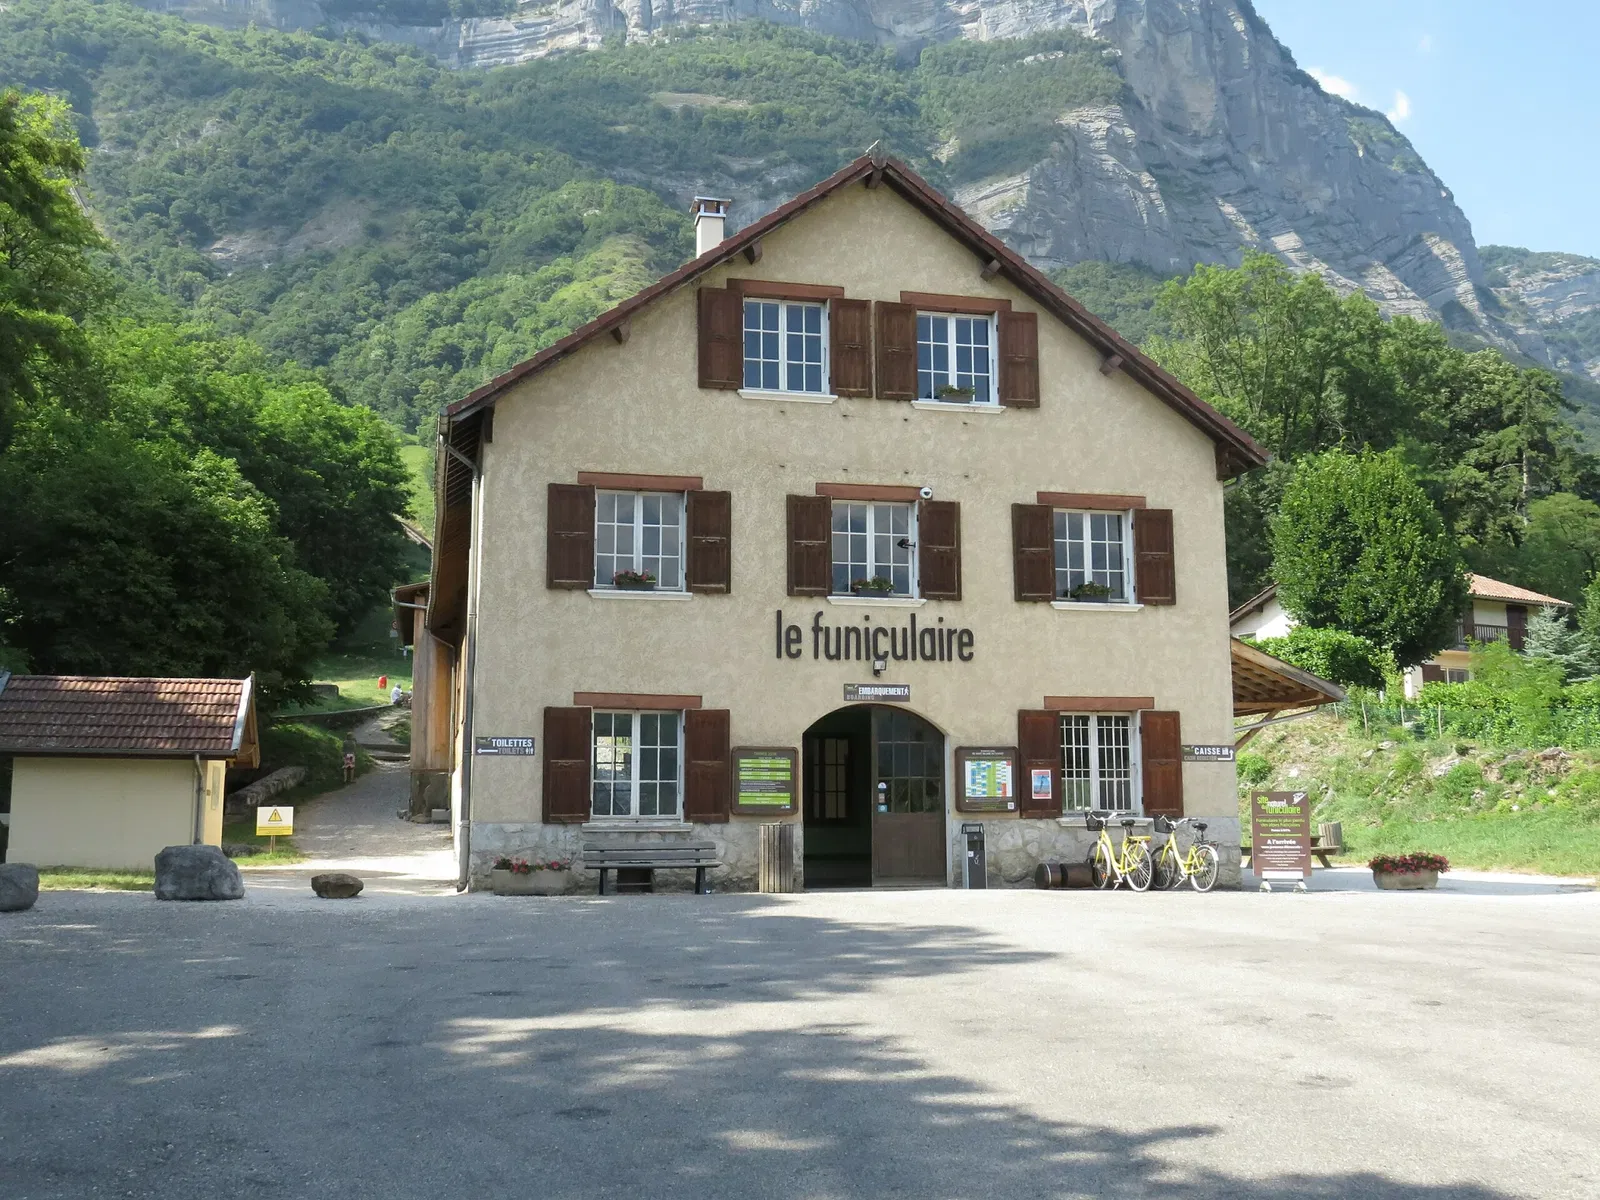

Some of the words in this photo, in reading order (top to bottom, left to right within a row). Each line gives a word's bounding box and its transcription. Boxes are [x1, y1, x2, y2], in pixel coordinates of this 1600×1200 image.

[776, 609, 802, 659] le
[812, 610, 974, 662] funiculaire
[859, 687, 904, 696] EMBARQUEMENT
[491, 739, 533, 747] TOILETTES
[1194, 747, 1221, 755] CAISSE
